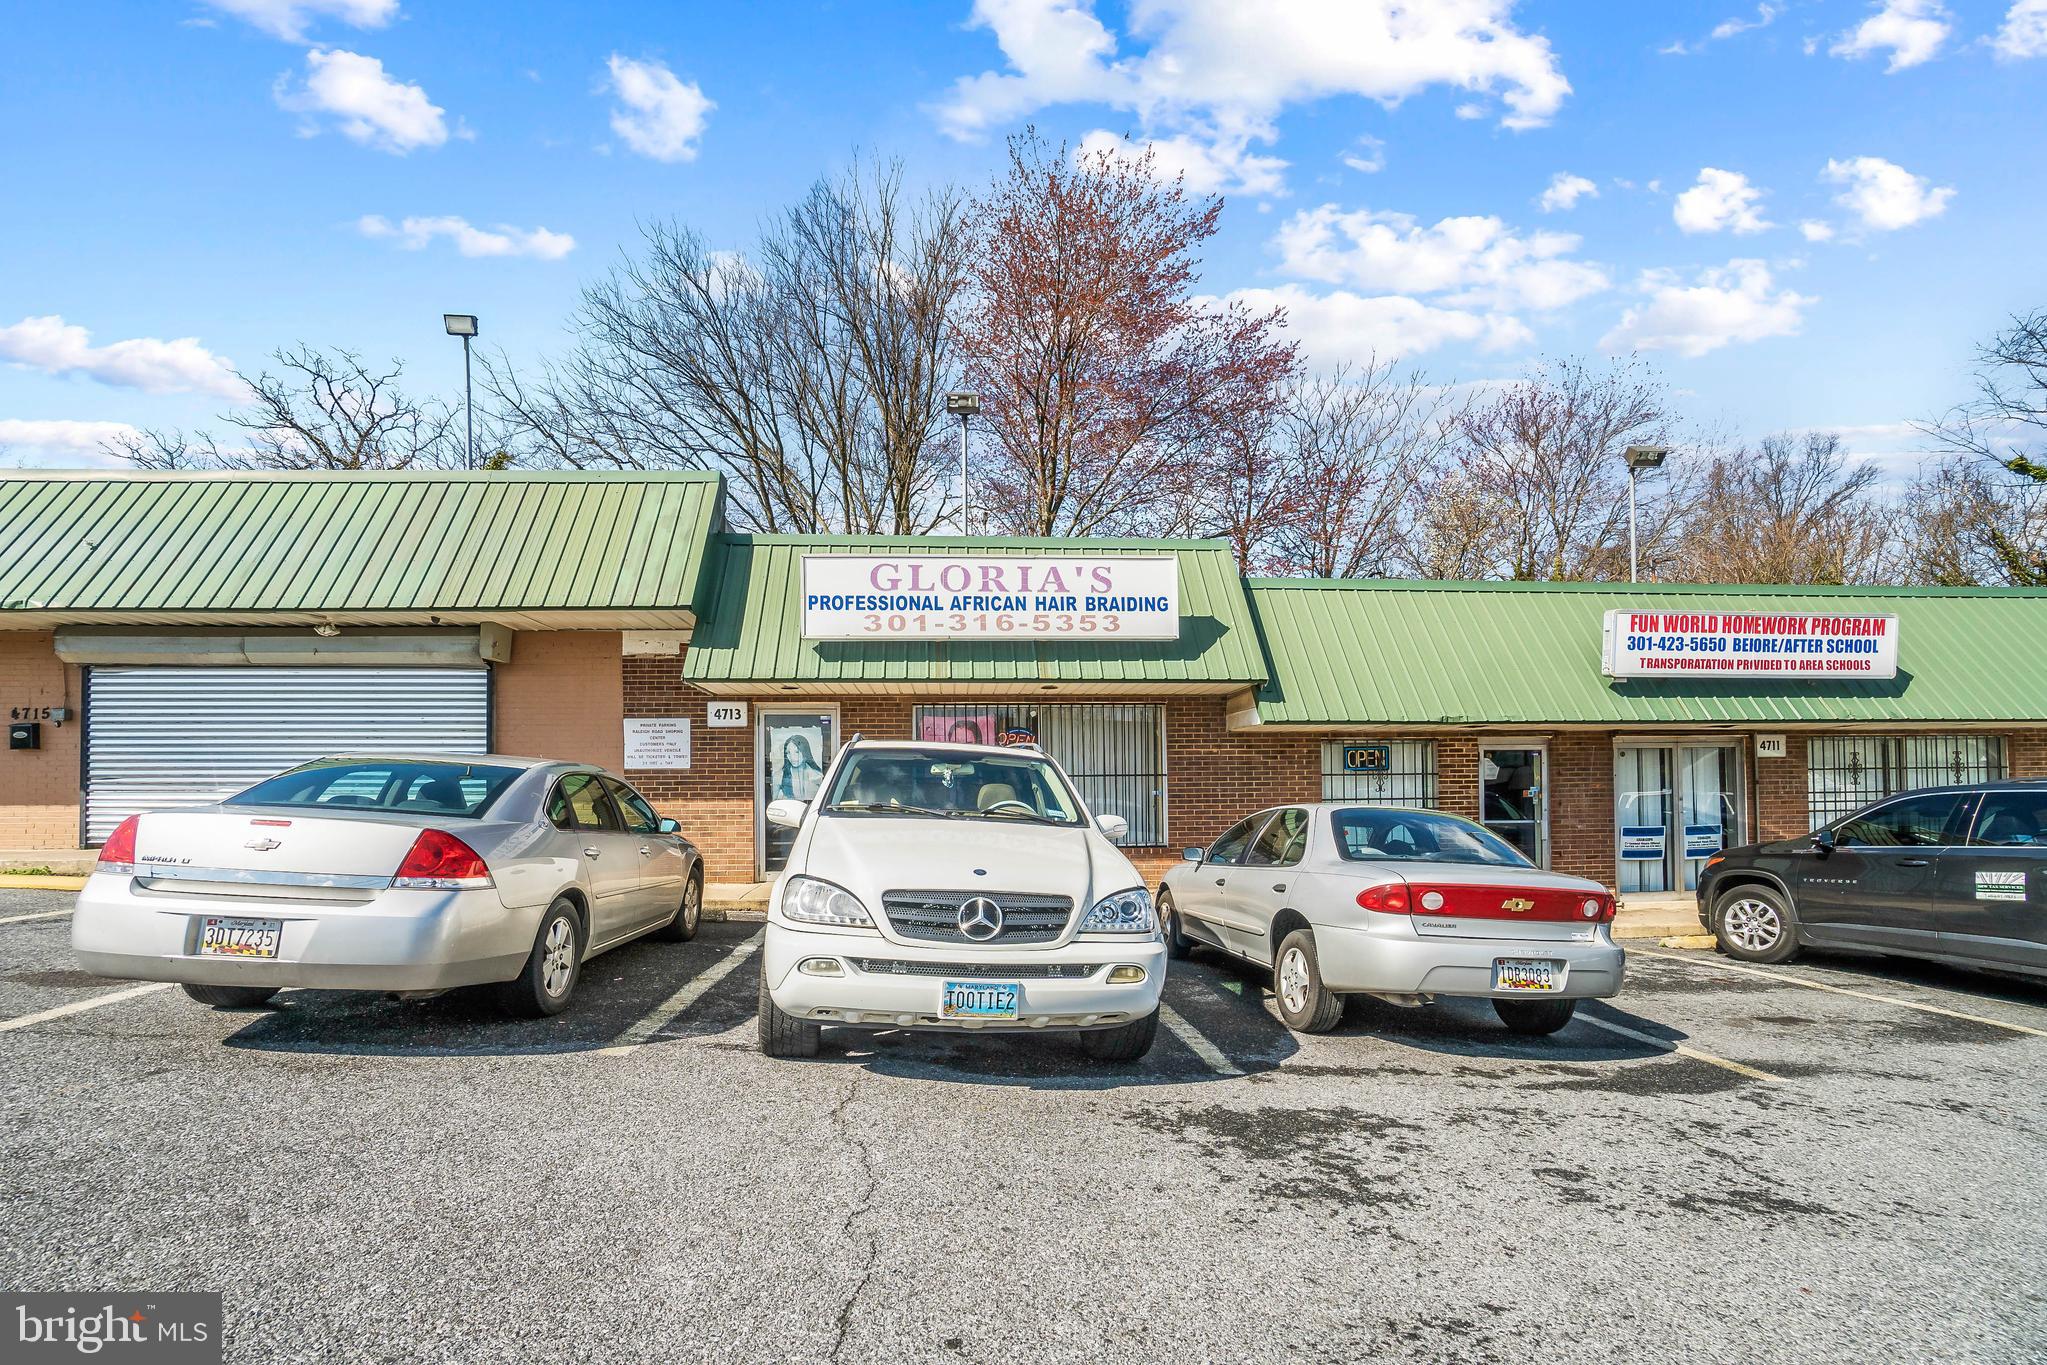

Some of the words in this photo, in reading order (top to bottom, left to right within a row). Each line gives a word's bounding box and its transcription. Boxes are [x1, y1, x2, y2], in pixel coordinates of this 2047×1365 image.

[870, 563, 1113, 593] GLORIA'S
[808, 595, 944, 611] PROFESSIONAL
[950, 595, 1027, 611] AFRICAN
[1035, 596, 1077, 611] HAIR
[1085, 596, 1169, 612] BRAIDING
[863, 614, 1120, 632] 301-316-5353
[1630, 615, 1659, 632] FUN
[1663, 615, 1718, 633] WORLD
[1722, 615, 1808, 635] HOMEWORK
[1811, 618, 1886, 636] PROGRAM
[1627, 635, 1726, 652] 301-423-5650
[1826, 639, 1879, 653] SCHOOL
[1640, 657, 1734, 670] TRANSPORATATION
[1784, 660, 1797, 670] TO
[1799, 660, 1824, 670] AREA
[1826, 660, 1871, 670] SCHOOLS
[714, 708, 741, 720] 4713
[998, 732, 1036, 744] OPEN
[1760, 740, 1780, 750] 4711
[1347, 750, 1386, 767] OPEN
